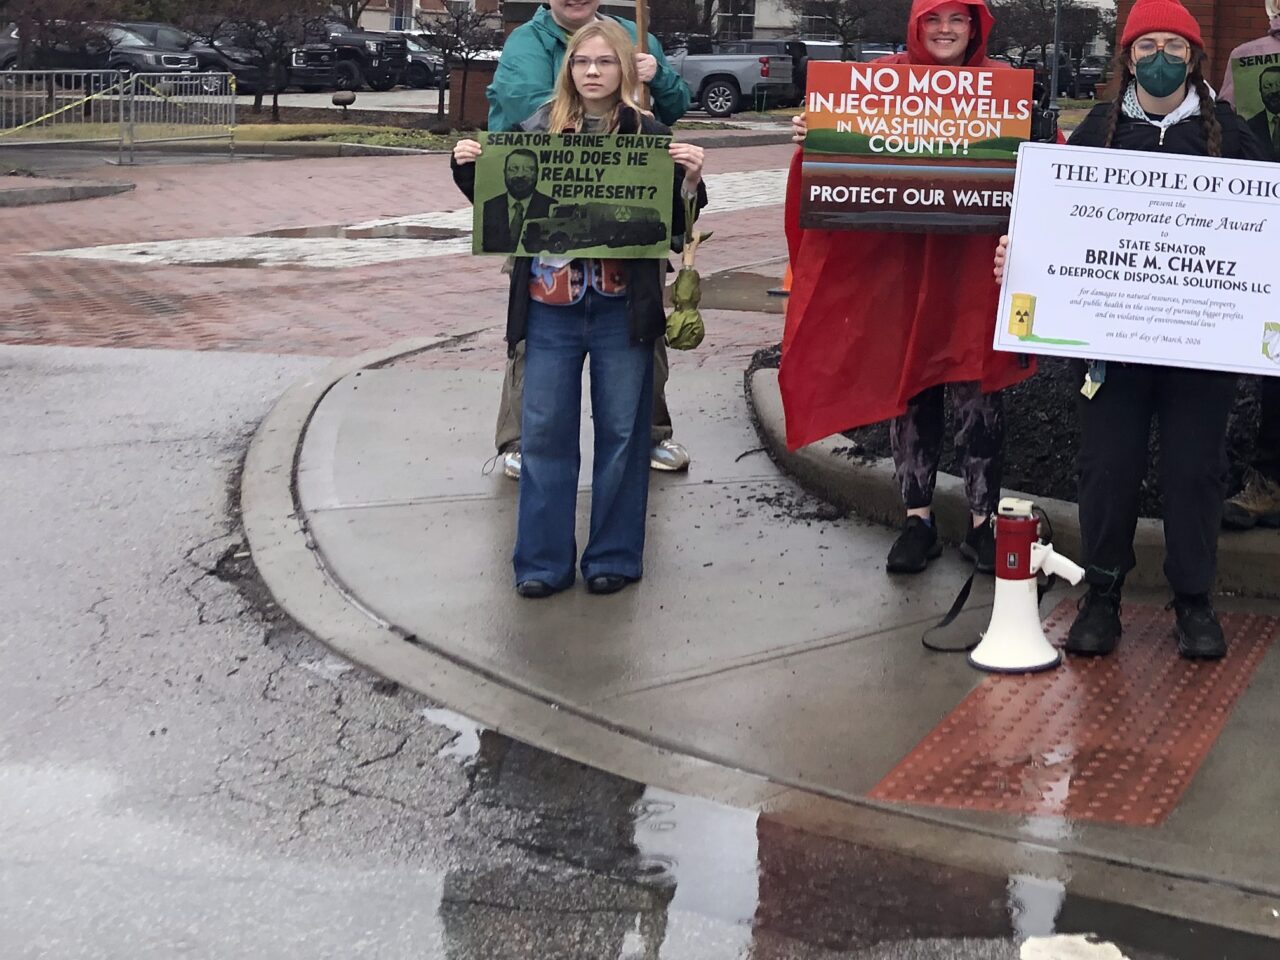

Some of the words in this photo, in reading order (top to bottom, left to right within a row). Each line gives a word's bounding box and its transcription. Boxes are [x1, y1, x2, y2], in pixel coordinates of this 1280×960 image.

[851, 66, 898, 92] NO
[909, 69, 992, 95] MORE
[809, 92, 942, 116] INJECTION
[951, 97, 1029, 120] WELLS
[837, 121, 851, 133] IN
[857, 117, 1001, 138] WASHINGTON
[487, 134, 550, 146] SENATOR
[558, 134, 610, 147] "BRINE"
[869, 136, 968, 154] COUNTY!
[540, 150, 573, 164] WHO
[581, 151, 620, 165] DOES
[628, 153, 648, 166] HE
[541, 167, 605, 182] REALLY
[1052, 163, 1098, 182] THE
[1103, 167, 1187, 190] PEOPLE
[1193, 175, 1223, 192] OF
[552, 184, 657, 200] REPRESENT?
[810, 185, 897, 204] PROTECT
[903, 189, 945, 205] OUR
[953, 190, 1012, 207] WATER
[1149, 200, 1173, 208] present
[1175, 200, 1186, 208] the
[1070, 204, 1103, 218] 2026
[1107, 208, 1171, 225] Corporate
[1175, 213, 1213, 228] Crime
[1215, 217, 1267, 233] Award
[1119, 239, 1150, 251] STATE
[1155, 242, 1206, 256] SENATOR
[1086, 249, 1138, 267] BRINE
[1144, 256, 1161, 269] M.
[1168, 257, 1237, 276] CHAVEZ
[1048, 265, 1055, 275] &
[1060, 266, 1120, 280] DEEPROCK
[1124, 272, 1179, 286] DISPOSAL
[1183, 277, 1247, 292] SOLUTIONS
[1252, 283, 1271, 294] LLC
